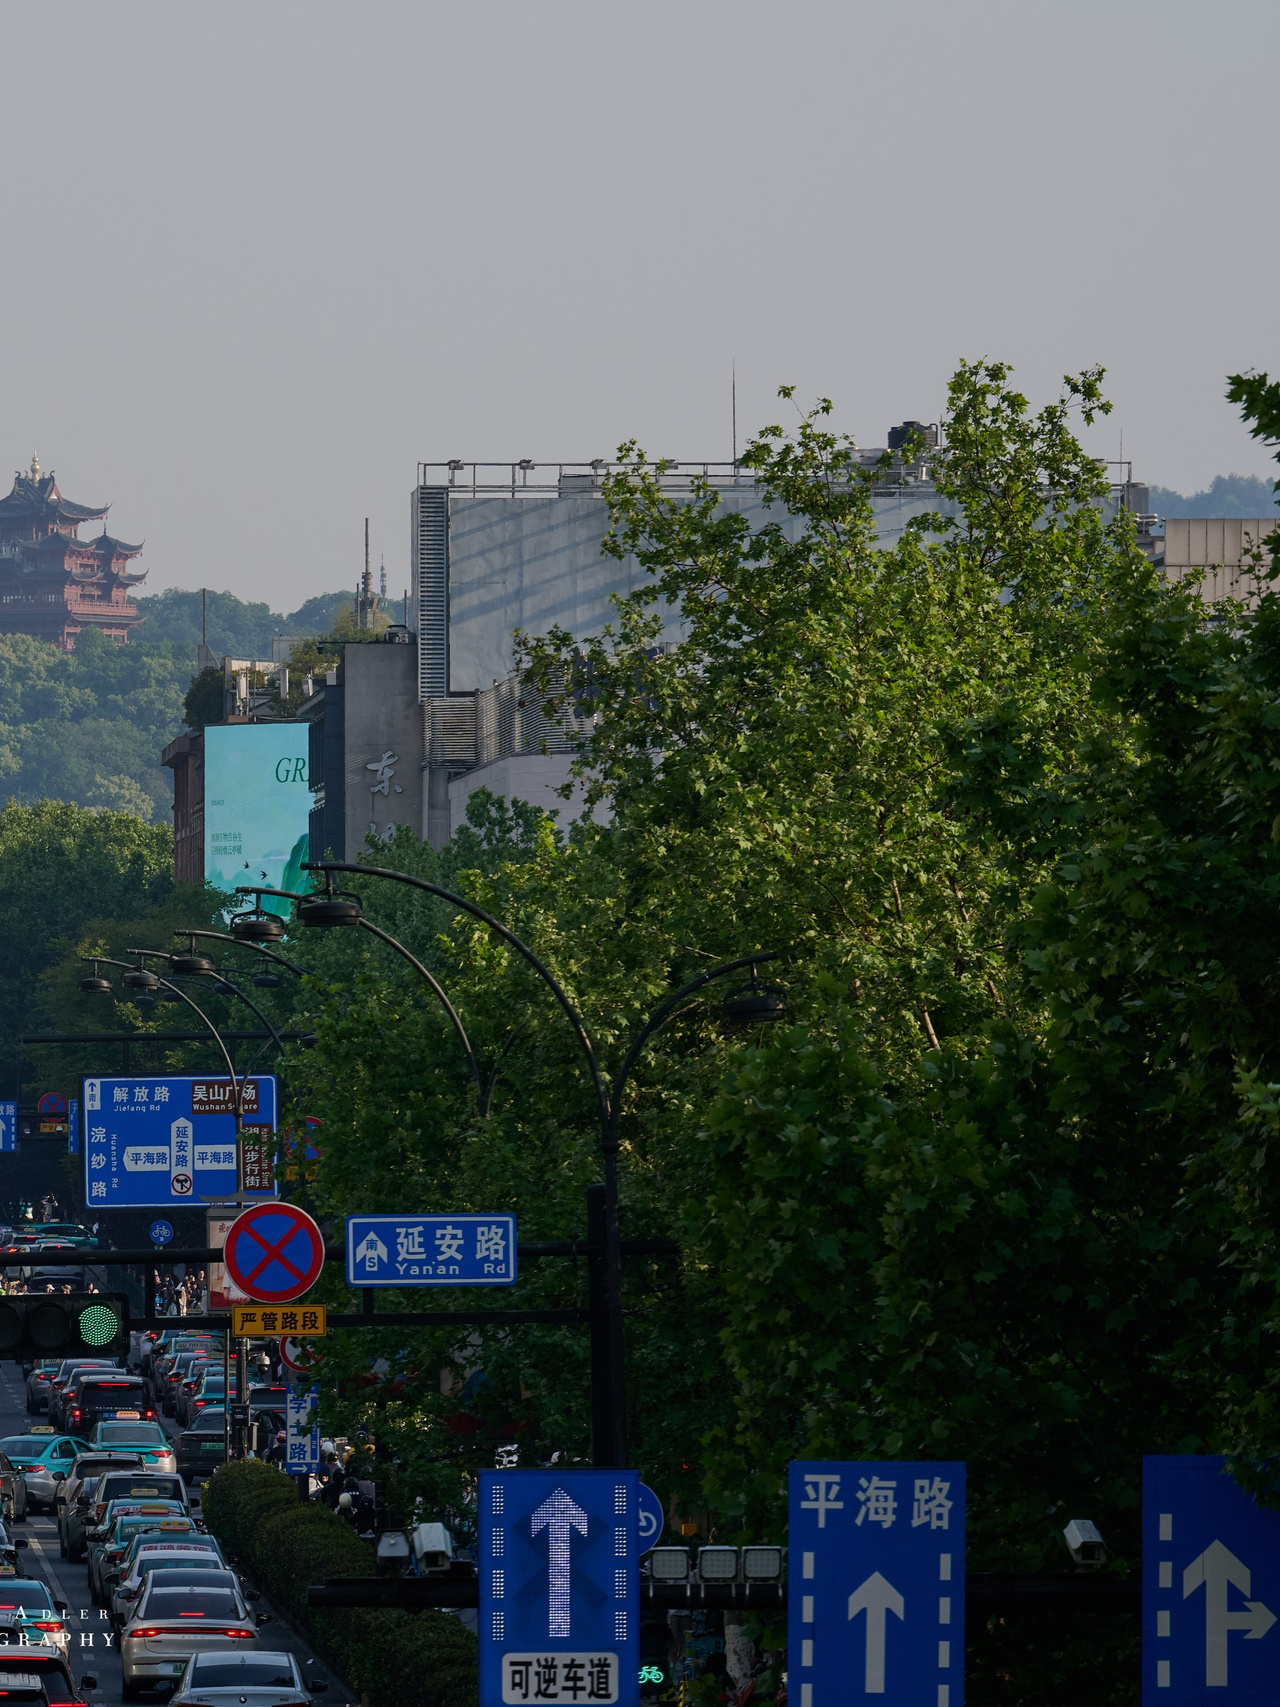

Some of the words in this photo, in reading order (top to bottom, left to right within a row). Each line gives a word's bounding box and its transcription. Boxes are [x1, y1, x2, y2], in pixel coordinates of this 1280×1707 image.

[113, 1086, 170, 1102] 解放路
[192, 1084, 256, 1101] 吴山广场
[113, 1105, 146, 1113] Jiefang
[110, 1134, 118, 1172] Huansha
[175, 1126, 188, 1167] 延安路
[90, 1126, 107, 1197] 浣纱路
[130, 1152, 168, 1165] 平海路
[197, 1151, 234, 1164] 平海路
[111, 1178, 118, 1188] Rd
[365, 1238, 378, 1252] 南
[395, 1225, 507, 1262] 延安路
[367, 1257, 377, 1268] S
[395, 1261, 460, 1275] Yan'an
[483, 1262, 506, 1274] Rd
[240, 1311, 319, 1331] 严管路段
[289, 1396, 307, 1461] 学士路
[800, 1474, 954, 1530] 平海路
[509, 1657, 612, 1700] 可逆车道
